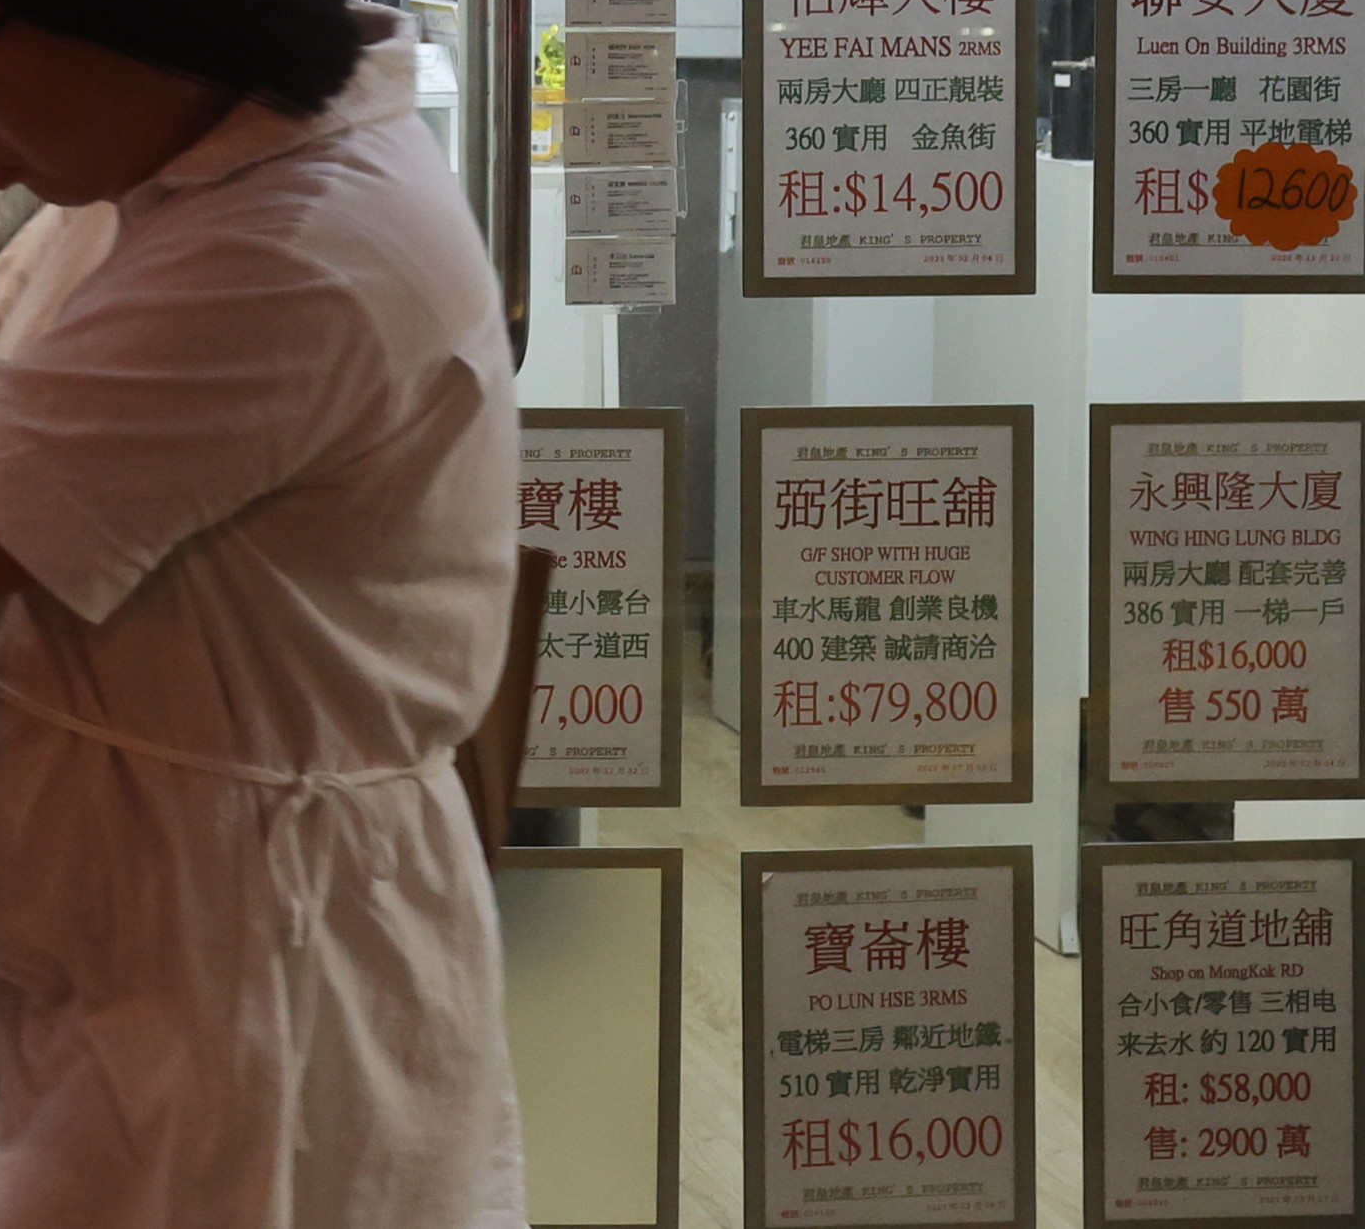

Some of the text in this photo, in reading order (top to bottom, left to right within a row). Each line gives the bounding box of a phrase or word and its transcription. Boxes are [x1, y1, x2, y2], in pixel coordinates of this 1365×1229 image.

[780, 36, 1001, 58] YEE FAI MANS 2RMS
[1137, 37, 1346, 57] Luen On Building 3RMS
[1129, 470, 1342, 512] 永興隆大廈
[831, 547, 873, 562] SHOP
[878, 547, 920, 561] WITH
[925, 546, 970, 561] HUGE
[815, 570, 955, 586] CUSTOMER FLOW
